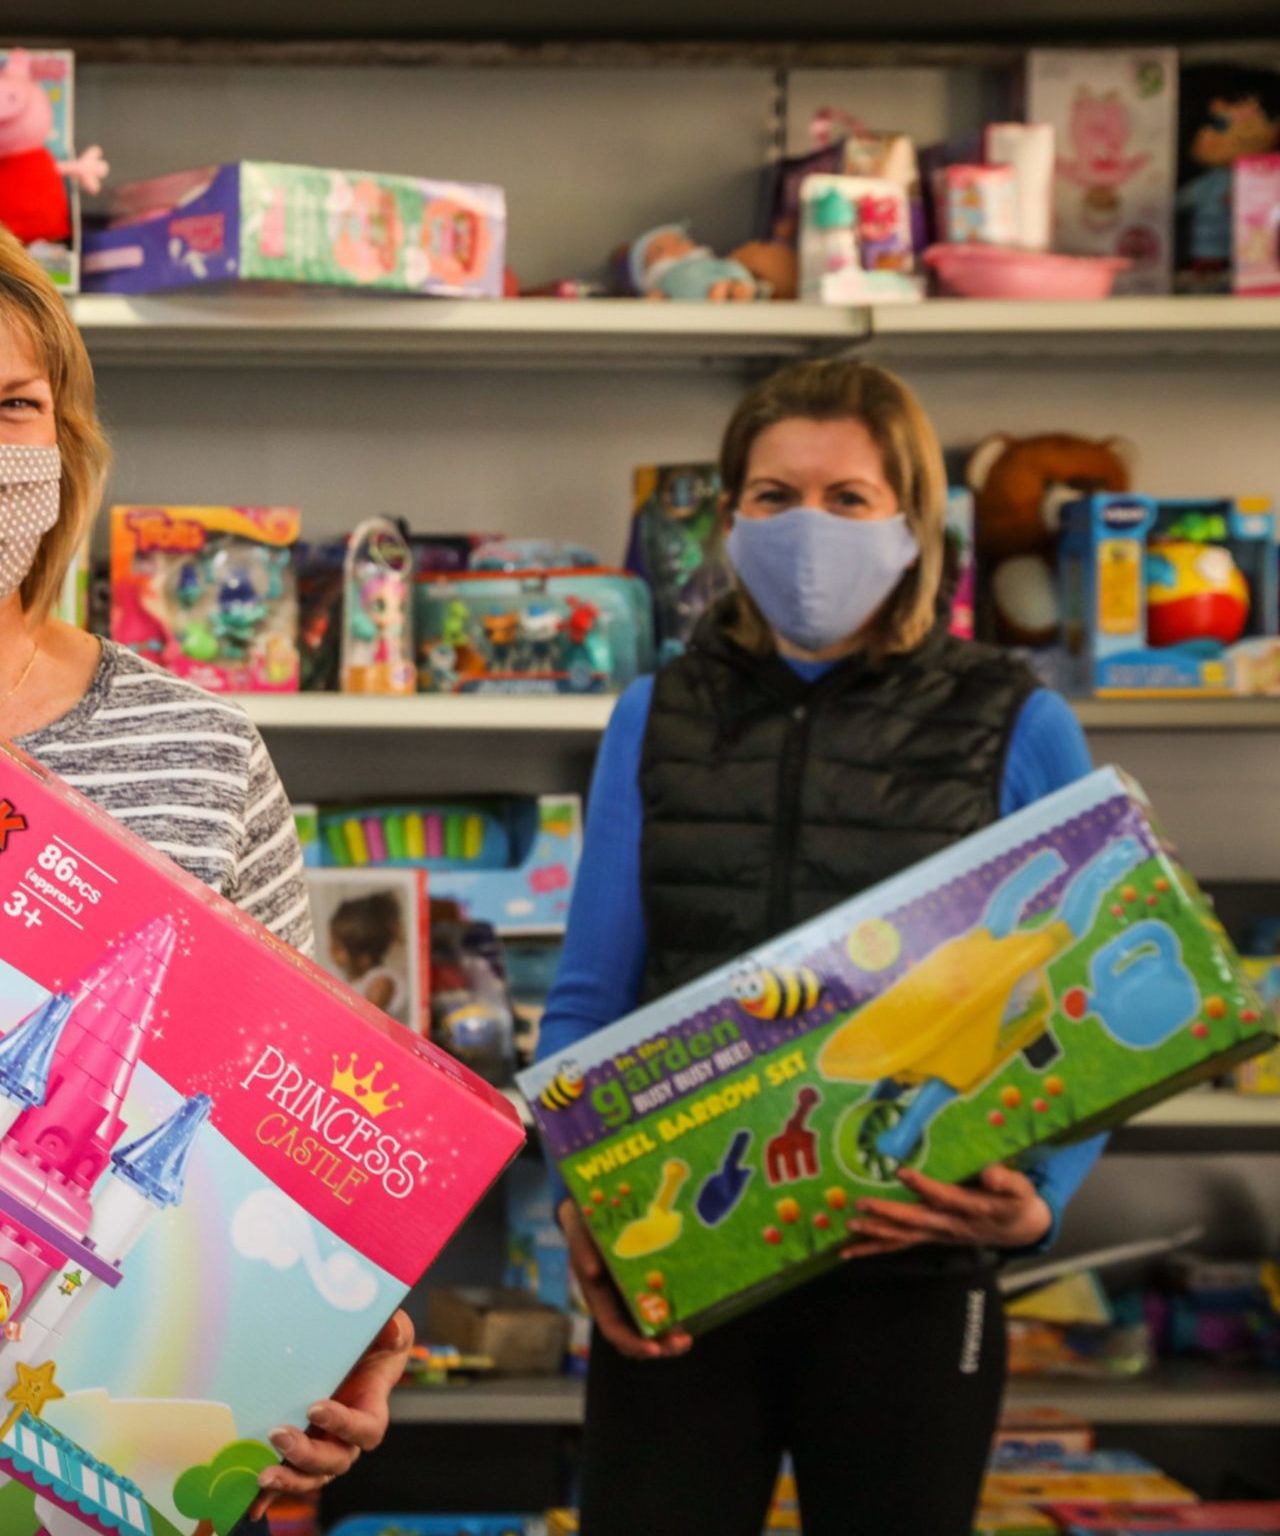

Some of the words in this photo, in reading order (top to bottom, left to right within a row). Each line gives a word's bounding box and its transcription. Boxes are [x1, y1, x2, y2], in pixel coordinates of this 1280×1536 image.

[3, 890, 43, 928] 3+
[25, 867, 84, 915] (approx.)
[240, 1045, 428, 1199] PRINCESS
[576, 1131, 656, 1181] WHEEL
[657, 1074, 760, 1142] BARROW
[764, 1050, 807, 1086] SET
[591, 1020, 740, 1126] garden
[255, 1113, 369, 1206] CASTLE
